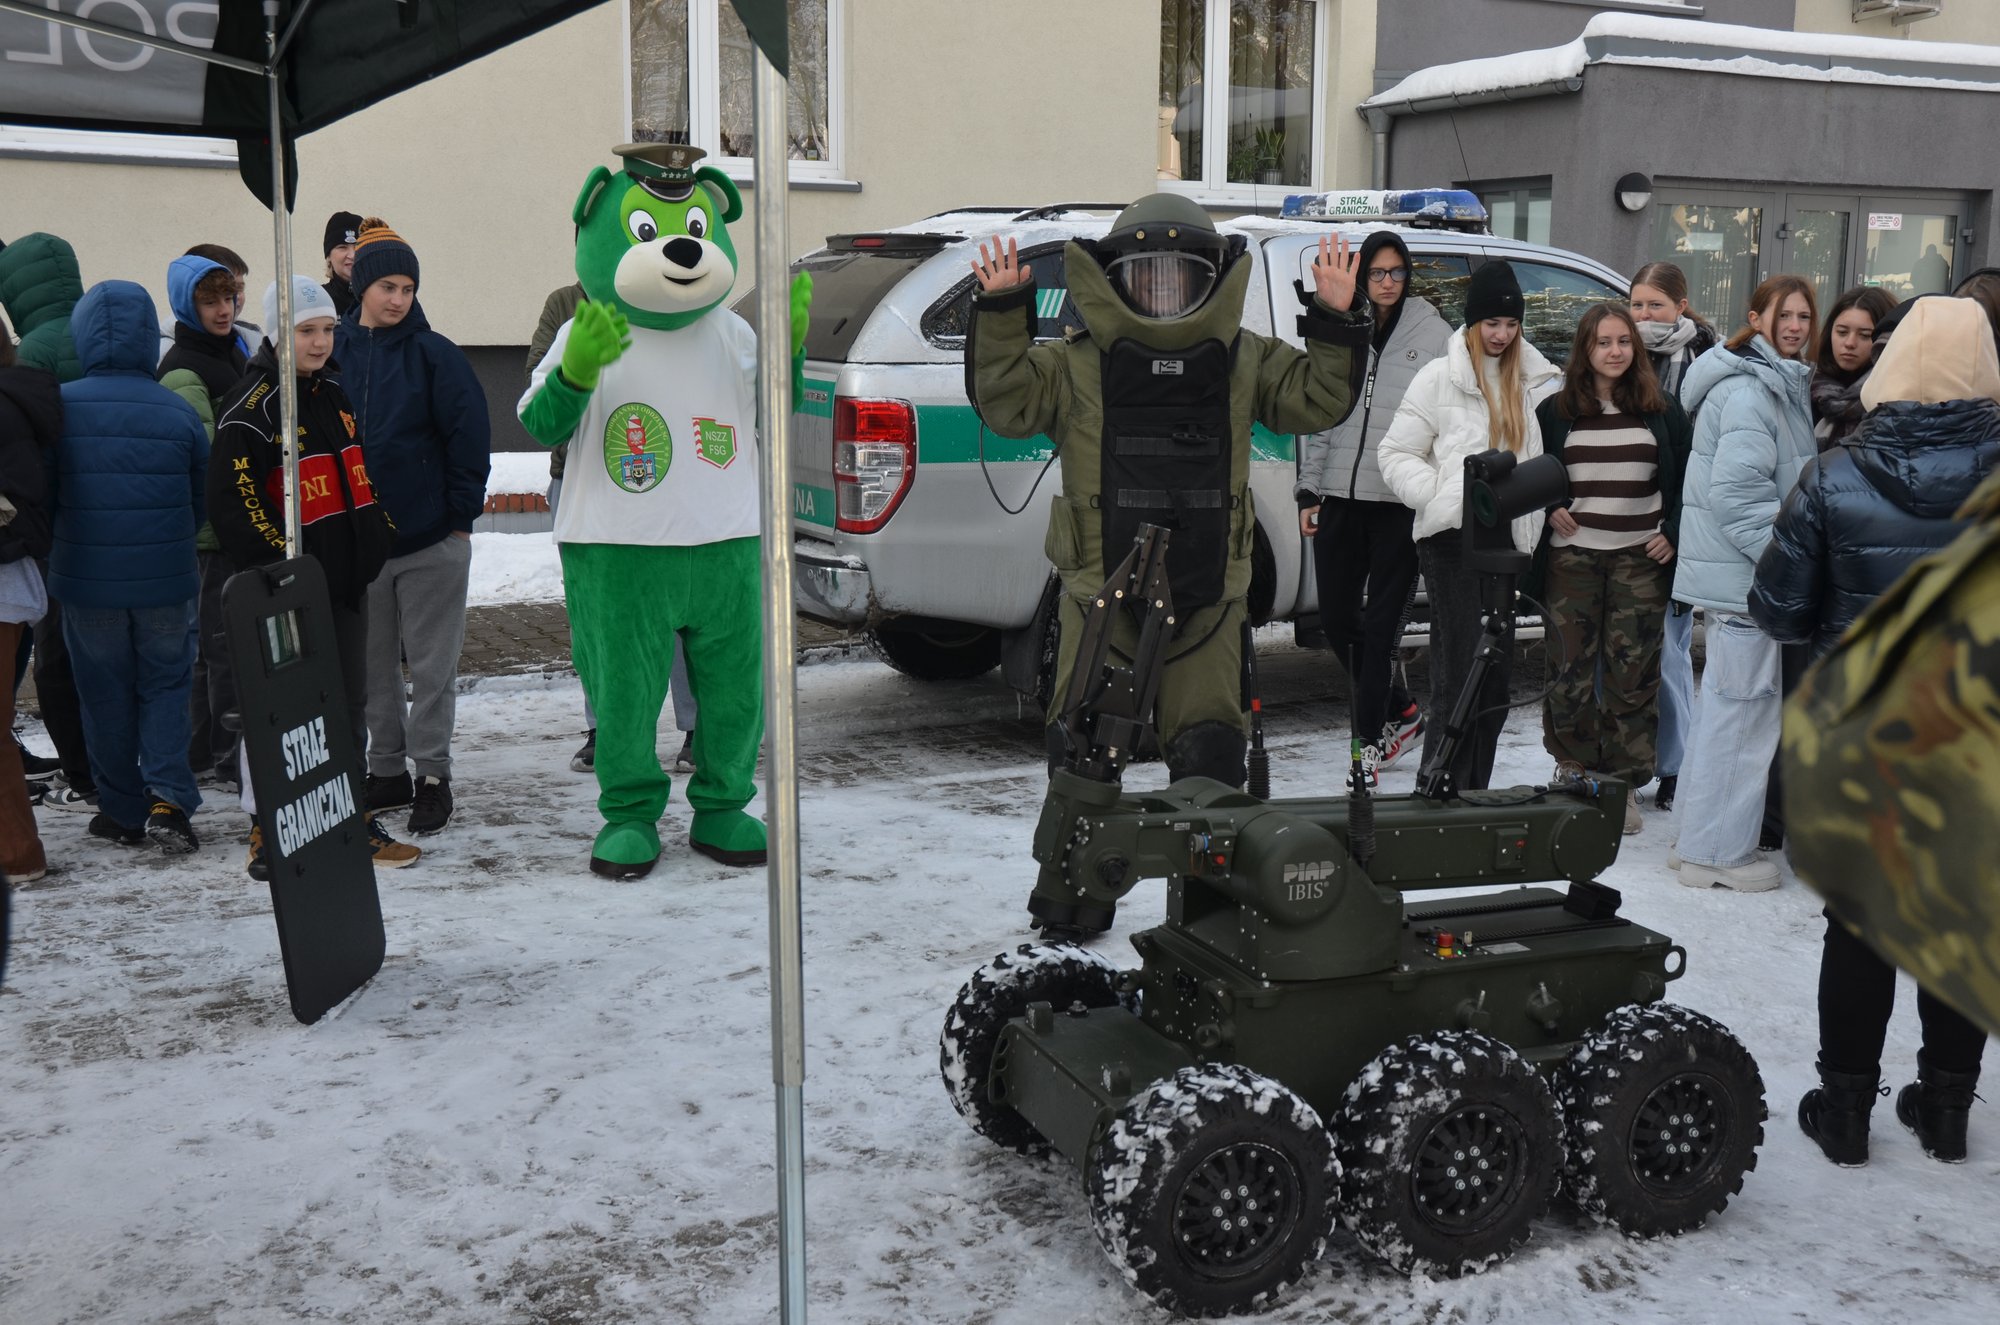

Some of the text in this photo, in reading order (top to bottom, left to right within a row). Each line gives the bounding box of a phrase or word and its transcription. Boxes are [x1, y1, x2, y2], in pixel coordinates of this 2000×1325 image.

[1329, 205, 1380, 216] GRANICZNA
[245, 382, 270, 410] UNITED
[705, 431, 728, 442] NSZZ
[709, 445, 727, 456] FSG
[232, 457, 287, 552] MANCHEST
[276, 771, 357, 858] GRANICZNA
[1283, 860, 1336, 883] PIAP
